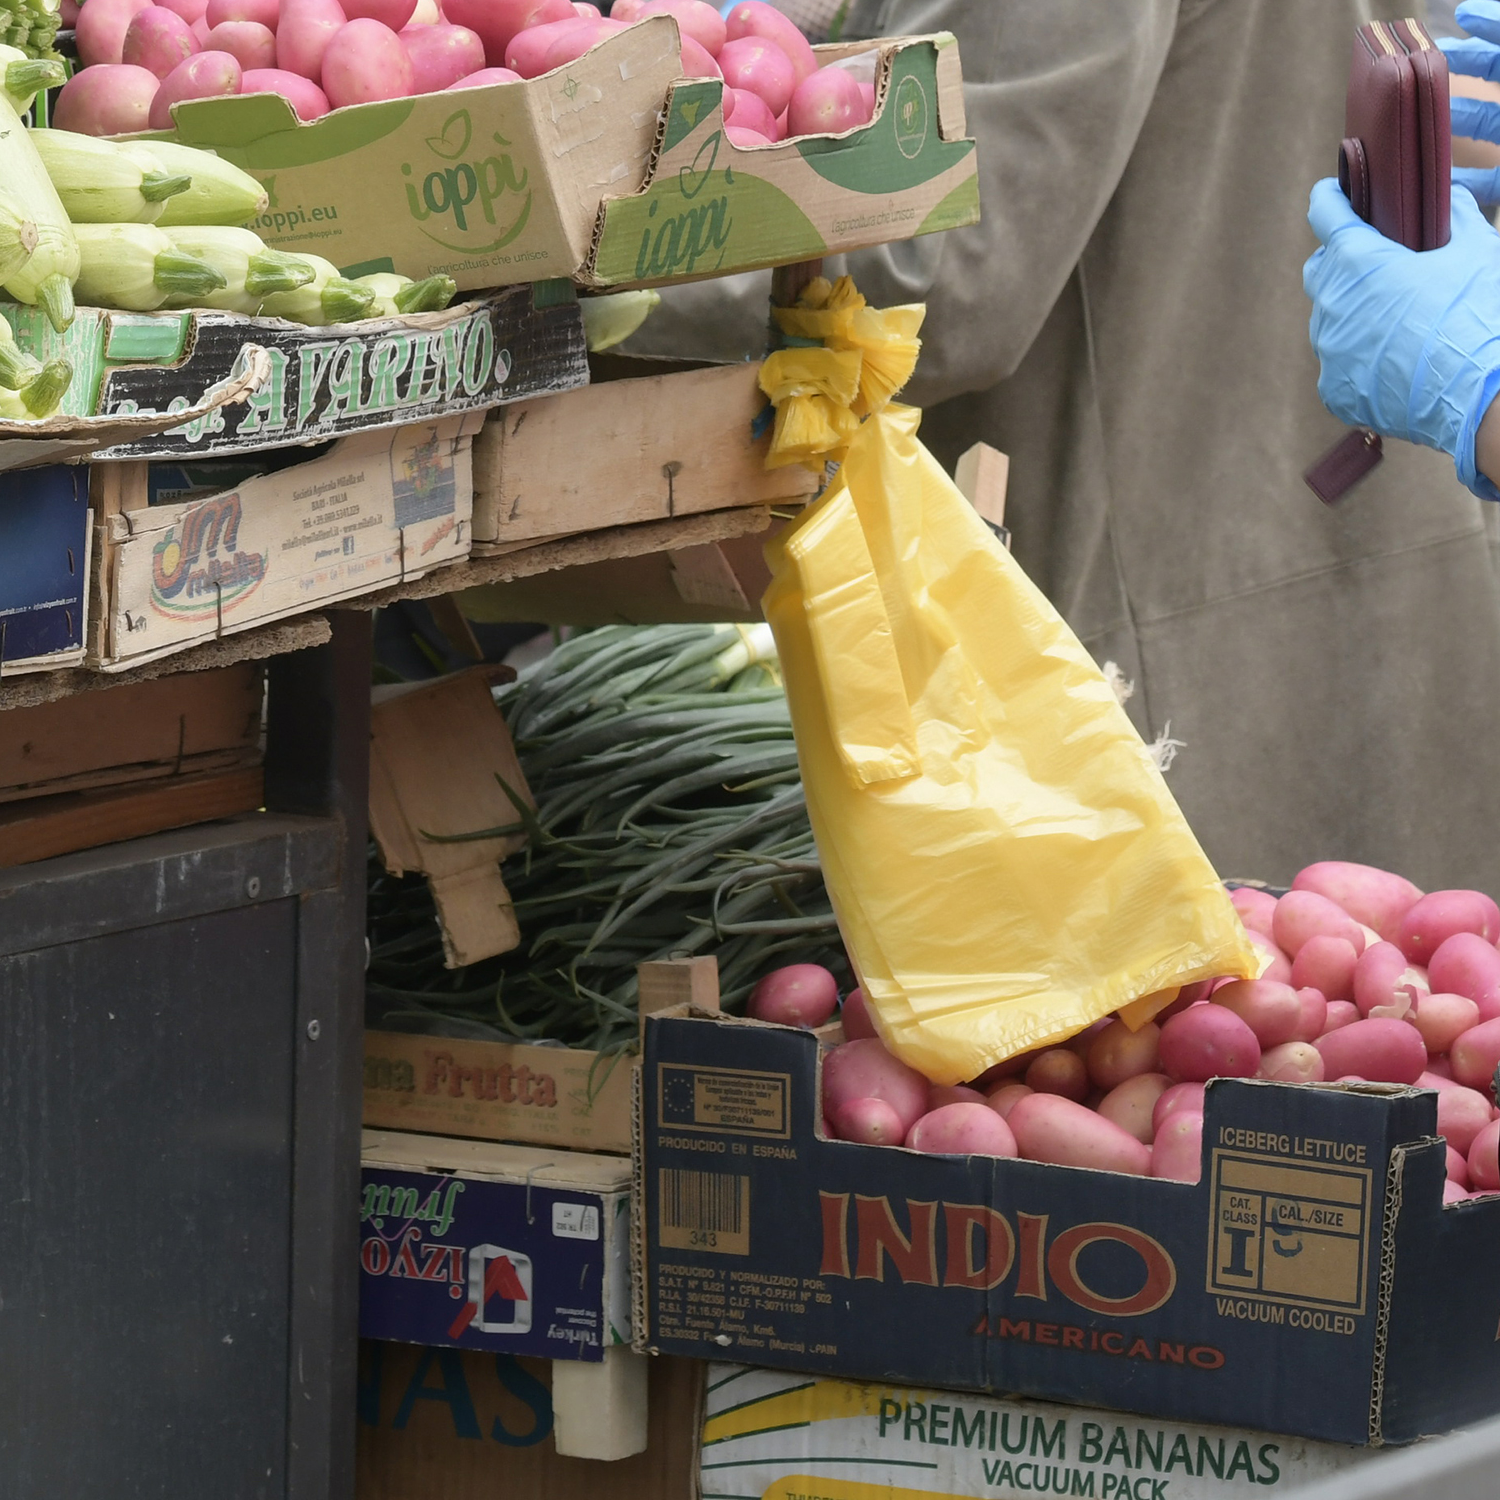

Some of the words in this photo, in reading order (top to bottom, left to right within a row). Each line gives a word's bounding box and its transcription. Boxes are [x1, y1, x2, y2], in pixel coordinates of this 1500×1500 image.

[492, 254, 512, 266] che
[514, 250, 549, 263] unisce
[423, 1050, 559, 1109] Frutta
[658, 1135, 726, 1154] PRODUCIDO
[731, 1143, 747, 1155] EN
[752, 1145, 798, 1160] ESPAÑA
[1219, 1126, 1290, 1153] ICEBERG
[1294, 1136, 1367, 1164] LETTUCE
[361, 1181, 466, 1237] fruit
[1222, 1209, 1258, 1225] CLASS
[1230, 1196, 1251, 1211] CAT.
[1278, 1204, 1344, 1227] CAL./SIZE
[690, 1230, 717, 1247] 343
[819, 1190, 1177, 1317] INDIO
[658, 1263, 715, 1278] PRODUCIDO
[719, 1270, 726, 1281] Y
[730, 1271, 798, 1289] NORMALIZADO
[1216, 1297, 1285, 1325] VACUUM
[1288, 1309, 1356, 1336] COOLED
[548, 1323, 599, 1347] Turkey
[974, 1313, 1227, 1370] AMERICANO
[879, 1399, 1067, 1456] PREMIUM
[1079, 1422, 1282, 1487] BANANAS
[982, 1457, 1096, 1495] VACUUM
[1101, 1474, 1170, 1500] PACK
